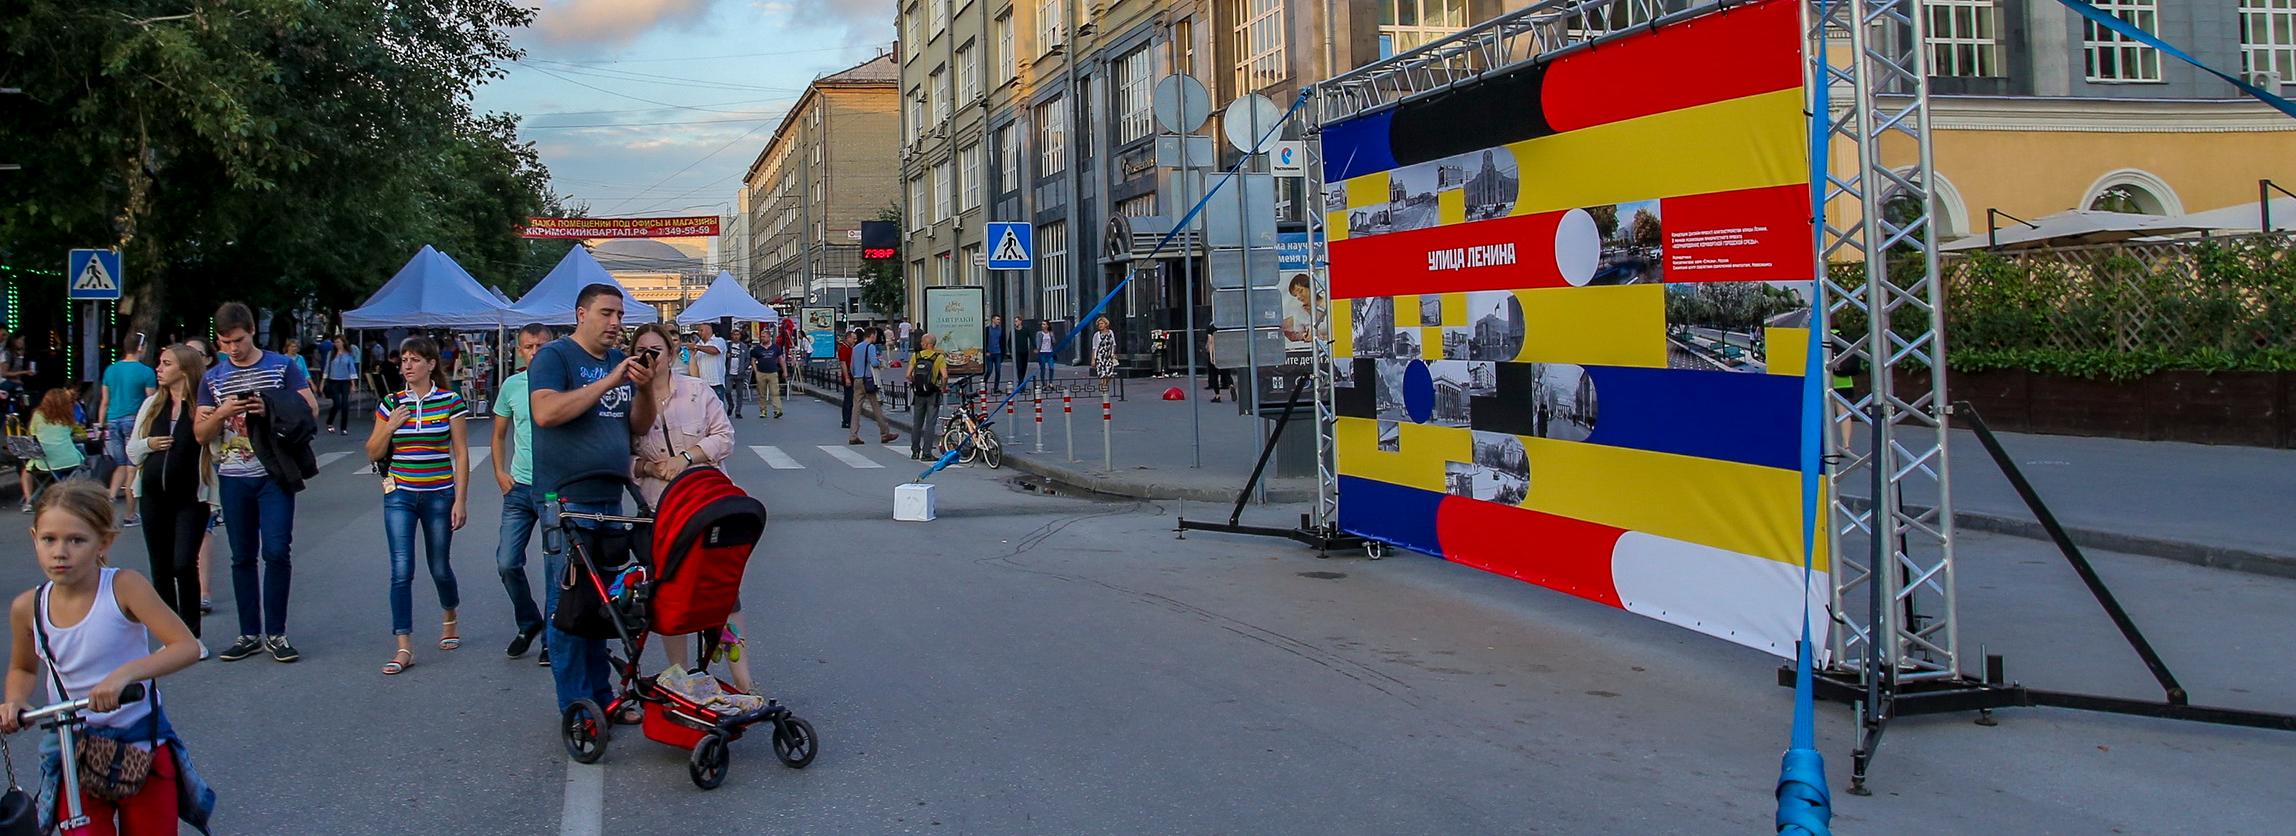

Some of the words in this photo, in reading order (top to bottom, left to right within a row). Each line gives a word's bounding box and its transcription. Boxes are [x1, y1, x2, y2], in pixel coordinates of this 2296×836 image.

[613, 219, 630, 228] ПОД
[632, 219, 663, 227] ОФИСЫ
[673, 217, 717, 226] МАГАЗИНЫ
[1428, 248, 1465, 270] УЛИЦА
[1467, 243, 1516, 267] ЛЕНИНА
